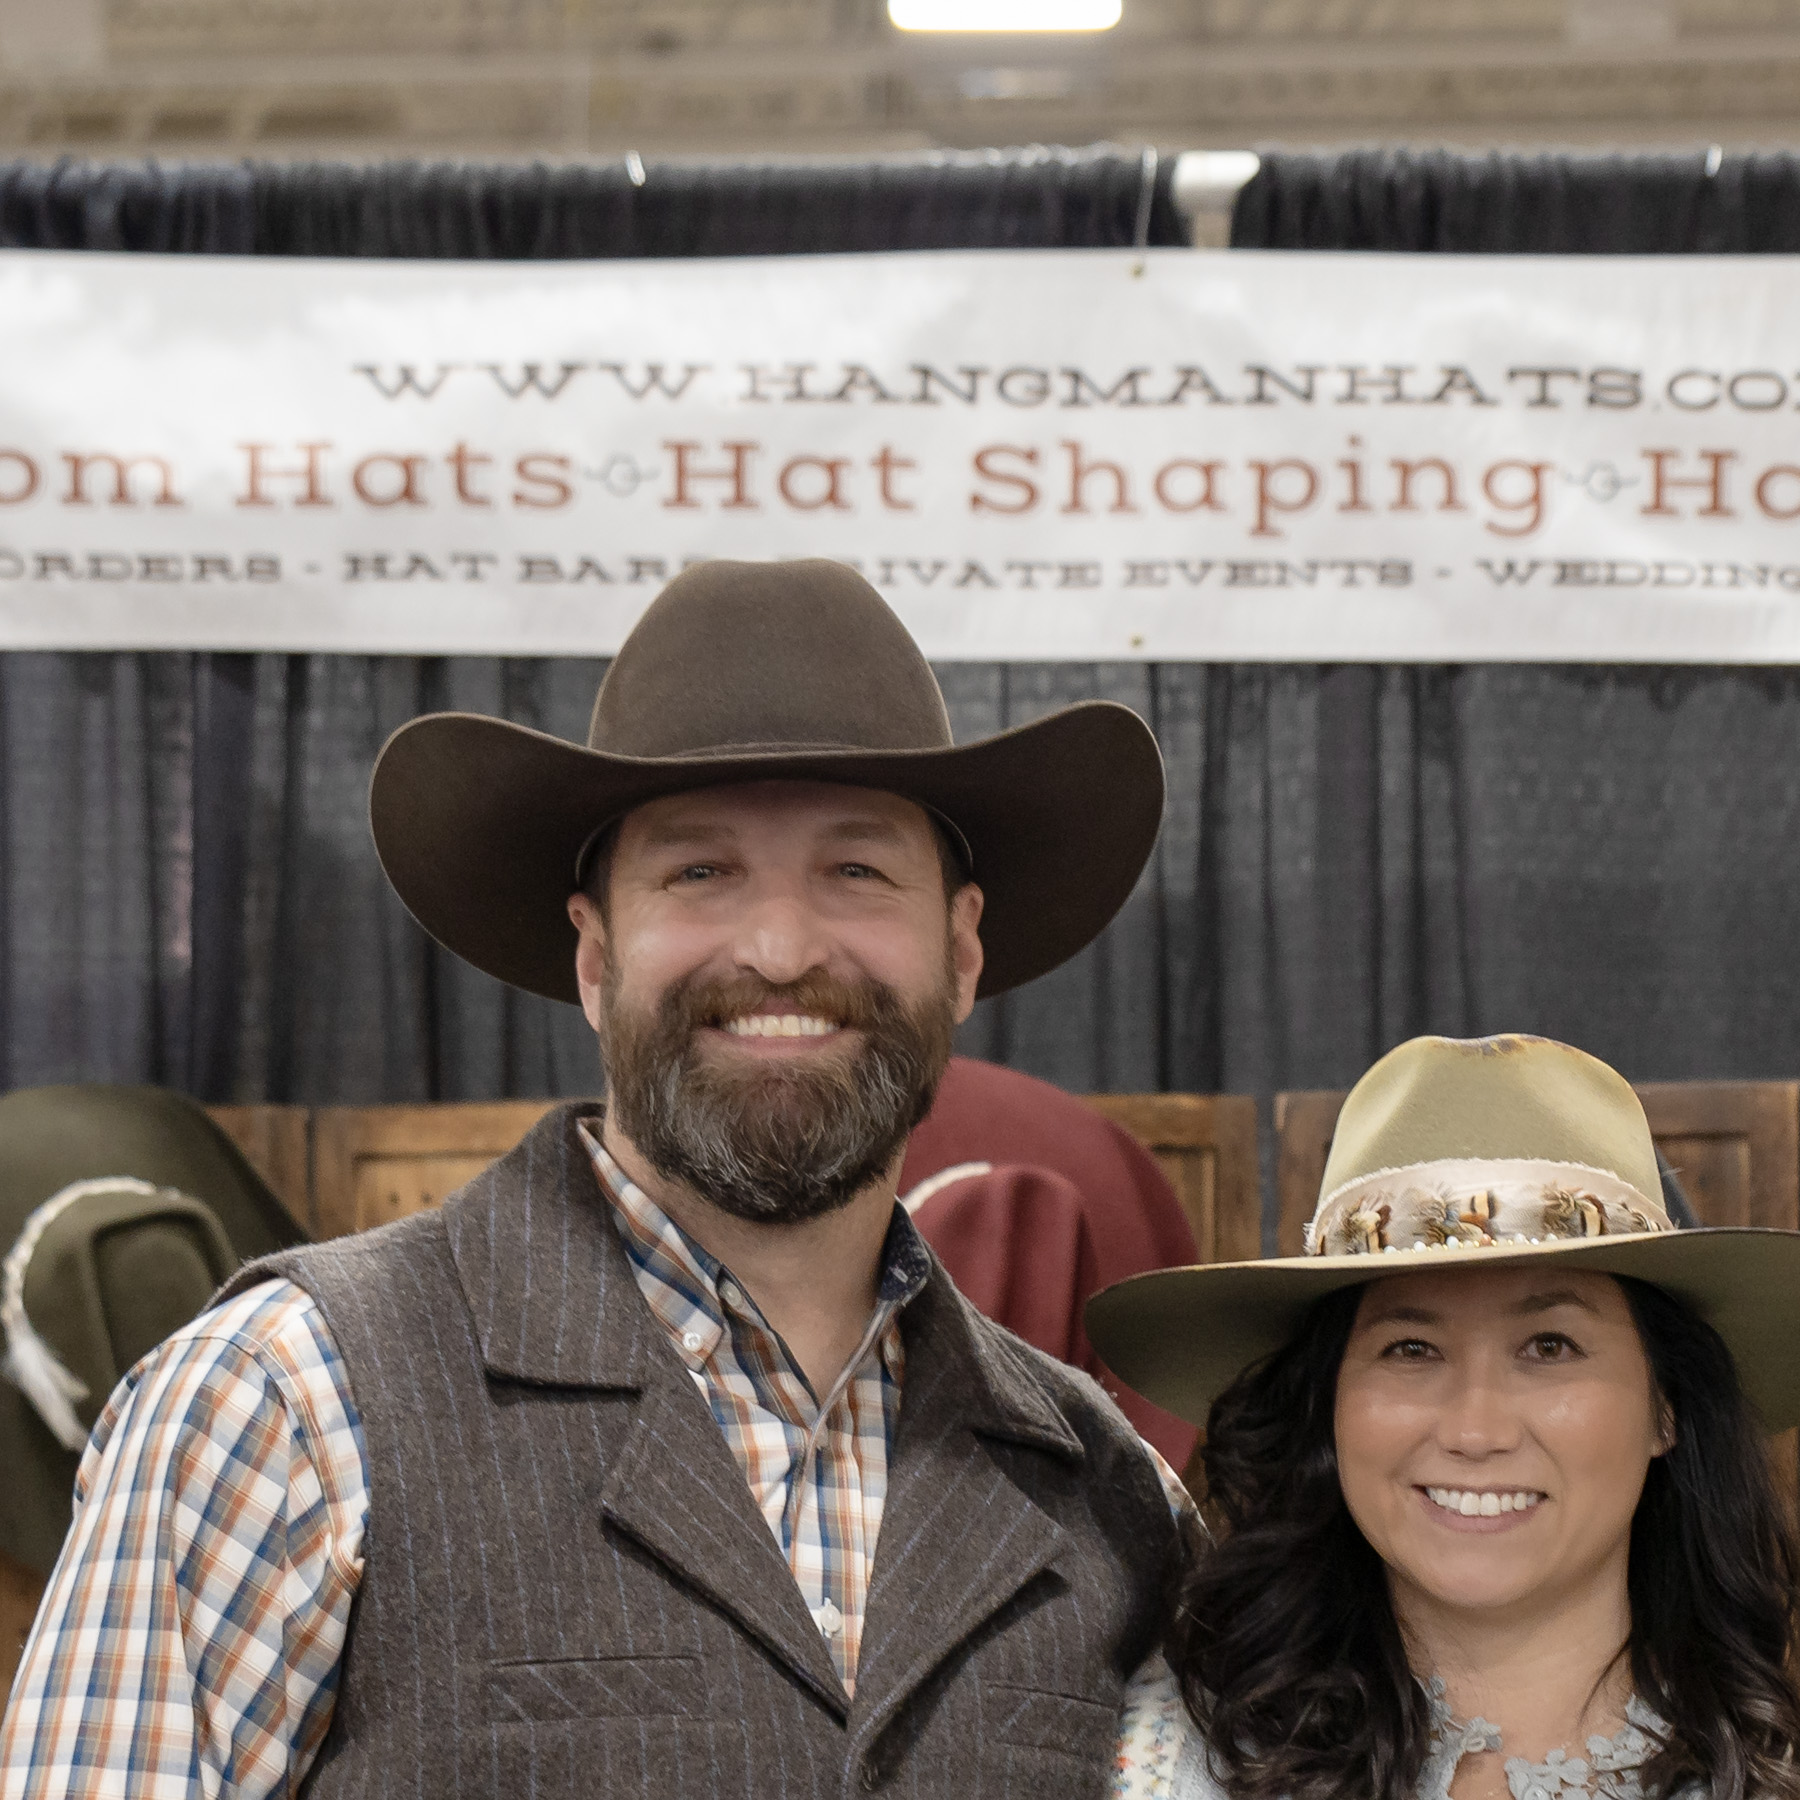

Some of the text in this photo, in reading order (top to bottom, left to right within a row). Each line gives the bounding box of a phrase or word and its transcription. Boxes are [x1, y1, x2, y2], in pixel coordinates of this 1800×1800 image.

[235, 441, 575, 511] Hats
[661, 440, 916, 513] Hat
[968, 434, 1555, 540] Shaping
[343, 551, 499, 584] HAT
[1122, 557, 1415, 589] EVENTS
